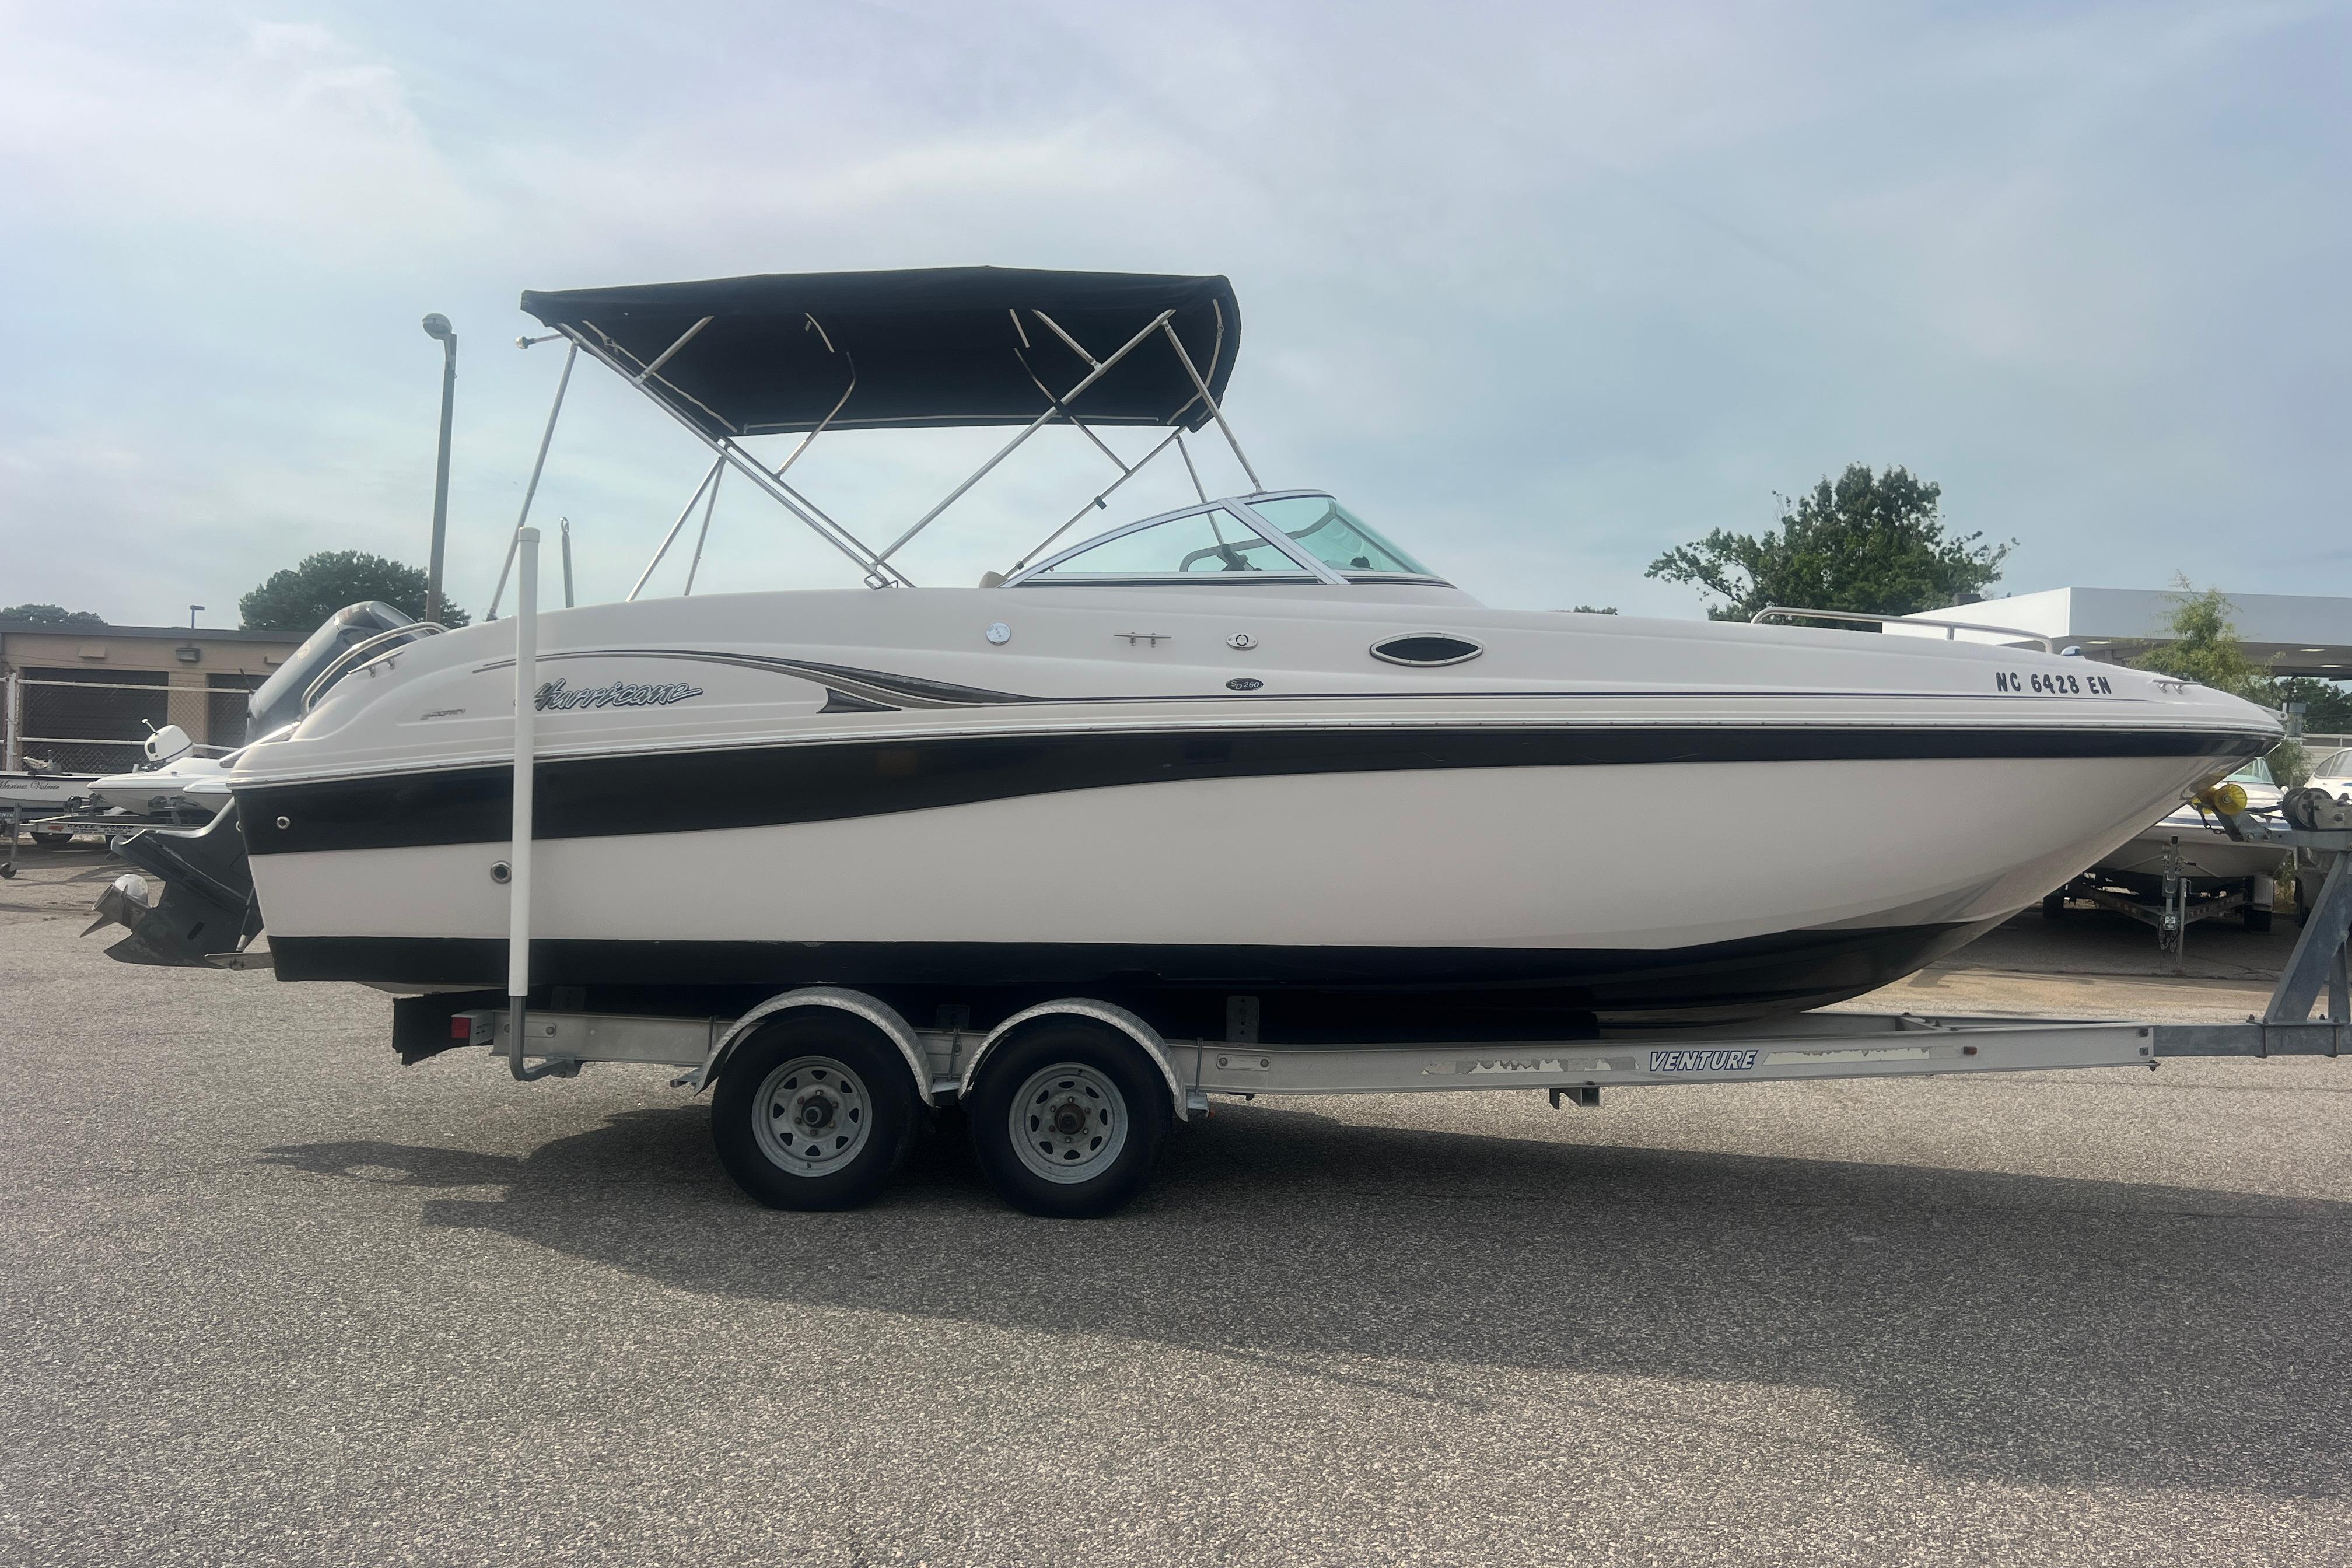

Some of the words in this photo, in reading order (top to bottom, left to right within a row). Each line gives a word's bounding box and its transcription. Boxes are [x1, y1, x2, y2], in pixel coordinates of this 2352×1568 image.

[534, 678, 703, 711] Hurricane
[1996, 672, 2021, 692] NC
[2031, 674, 2080, 694] 6428
[2086, 676, 2112, 695] EN
[1650, 1050, 1759, 1072] VENTURE
